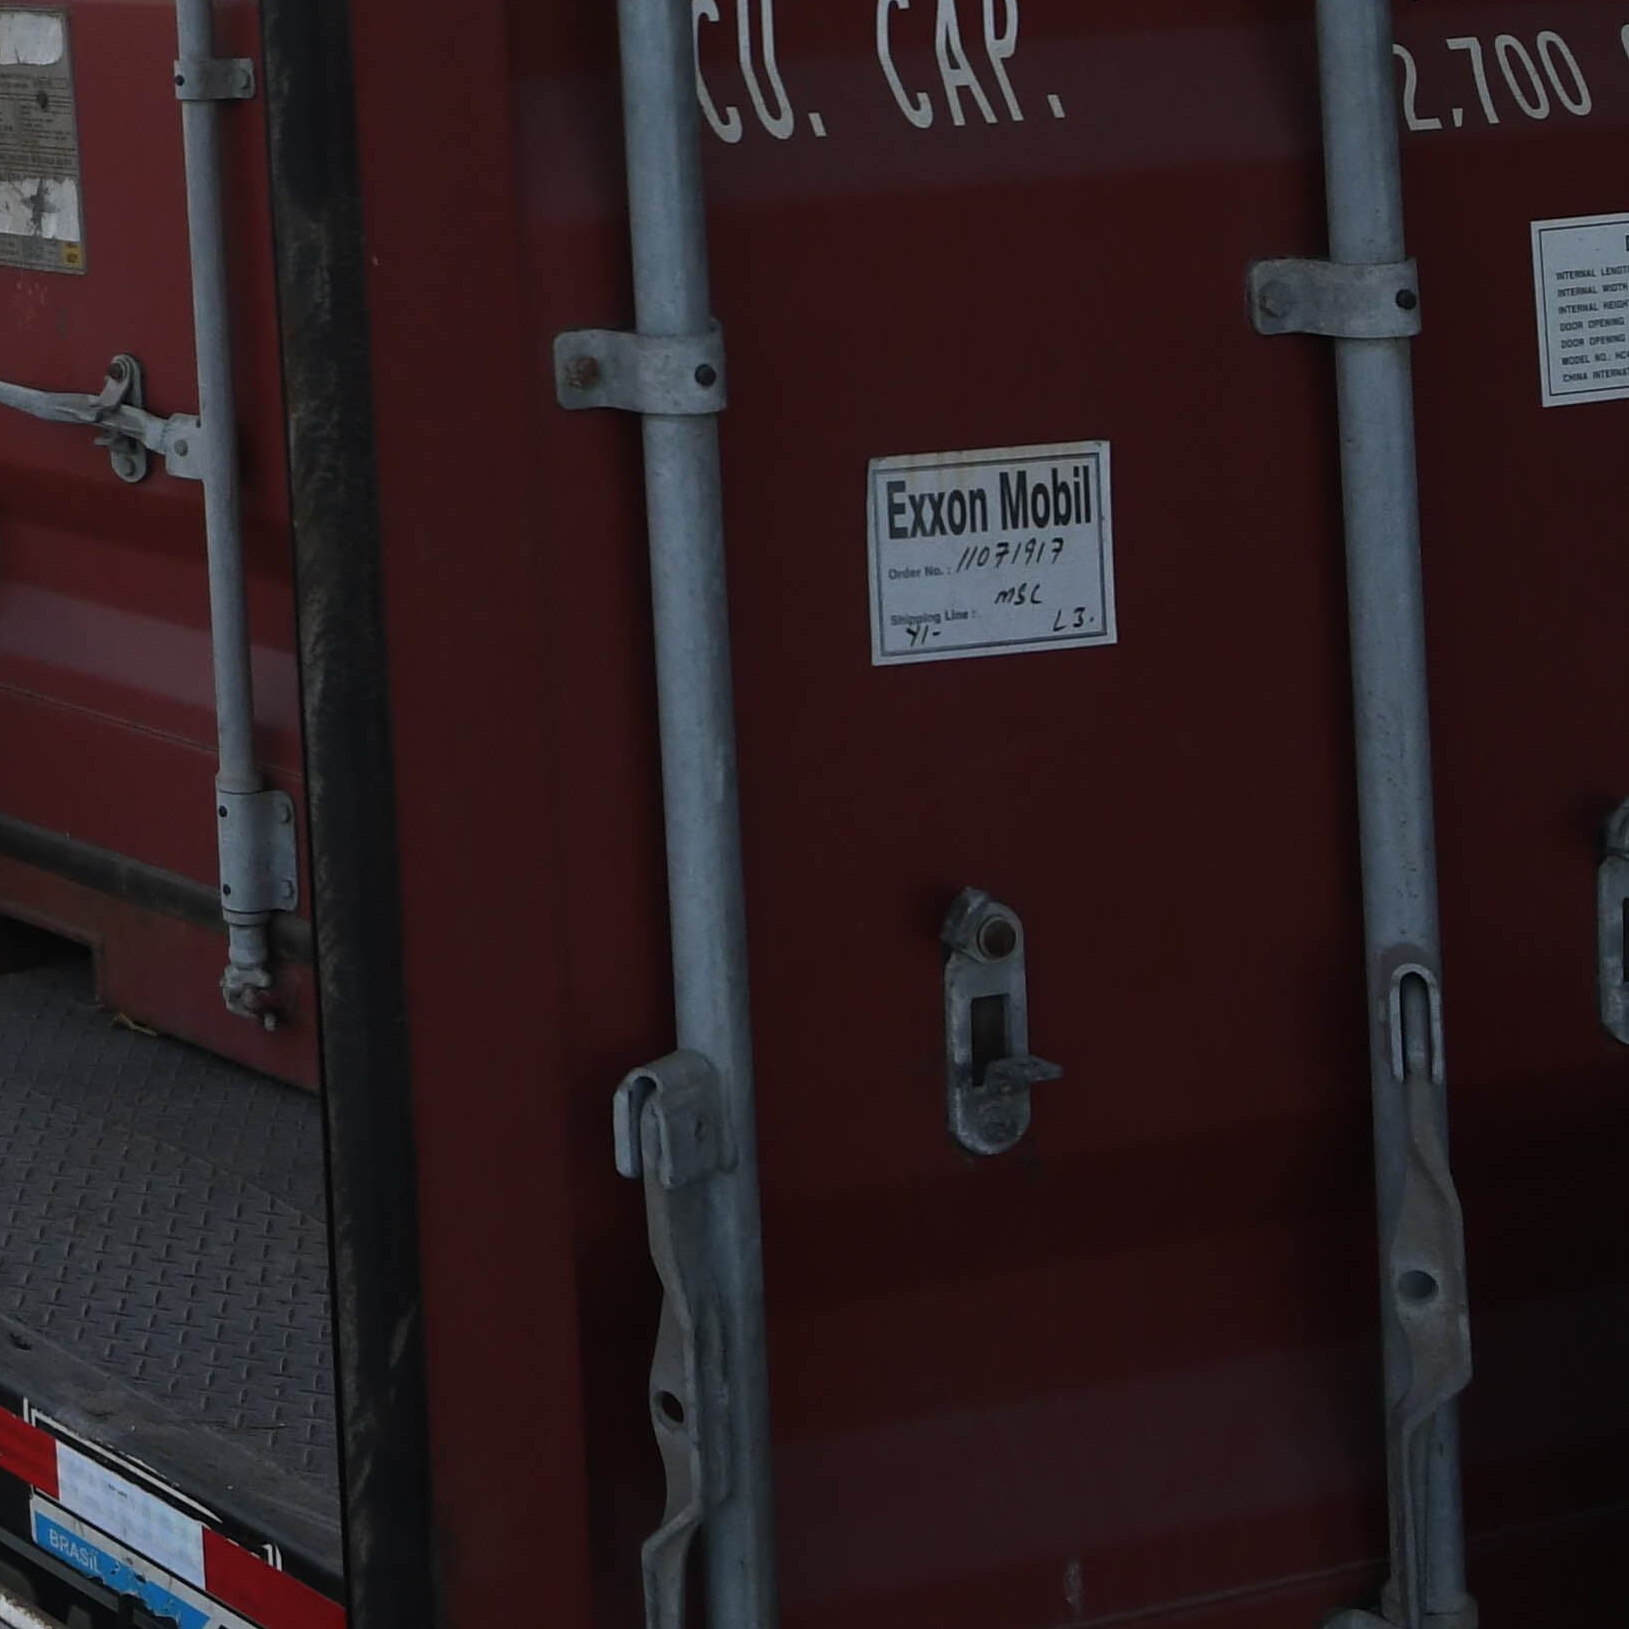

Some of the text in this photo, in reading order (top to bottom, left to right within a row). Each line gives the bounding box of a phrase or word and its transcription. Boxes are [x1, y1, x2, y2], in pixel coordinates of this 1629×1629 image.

[1392, 31, 1593, 131] 2,700
[1556, 268, 1596, 281] INTERNAL
[1558, 285, 1598, 298] INTERNAL
[1558, 302, 1599, 315] INTERNAL
[1560, 321, 1584, 332] DOOR
[1561, 338, 1585, 349] DOOR
[1561, 354, 1591, 366] MODEL
[1563, 371, 1588, 383] CHINA
[886, 465, 1092, 540] Exxon Mobil
[888, 569, 921, 580] Order
[890, 611, 941, 626] Shipping
